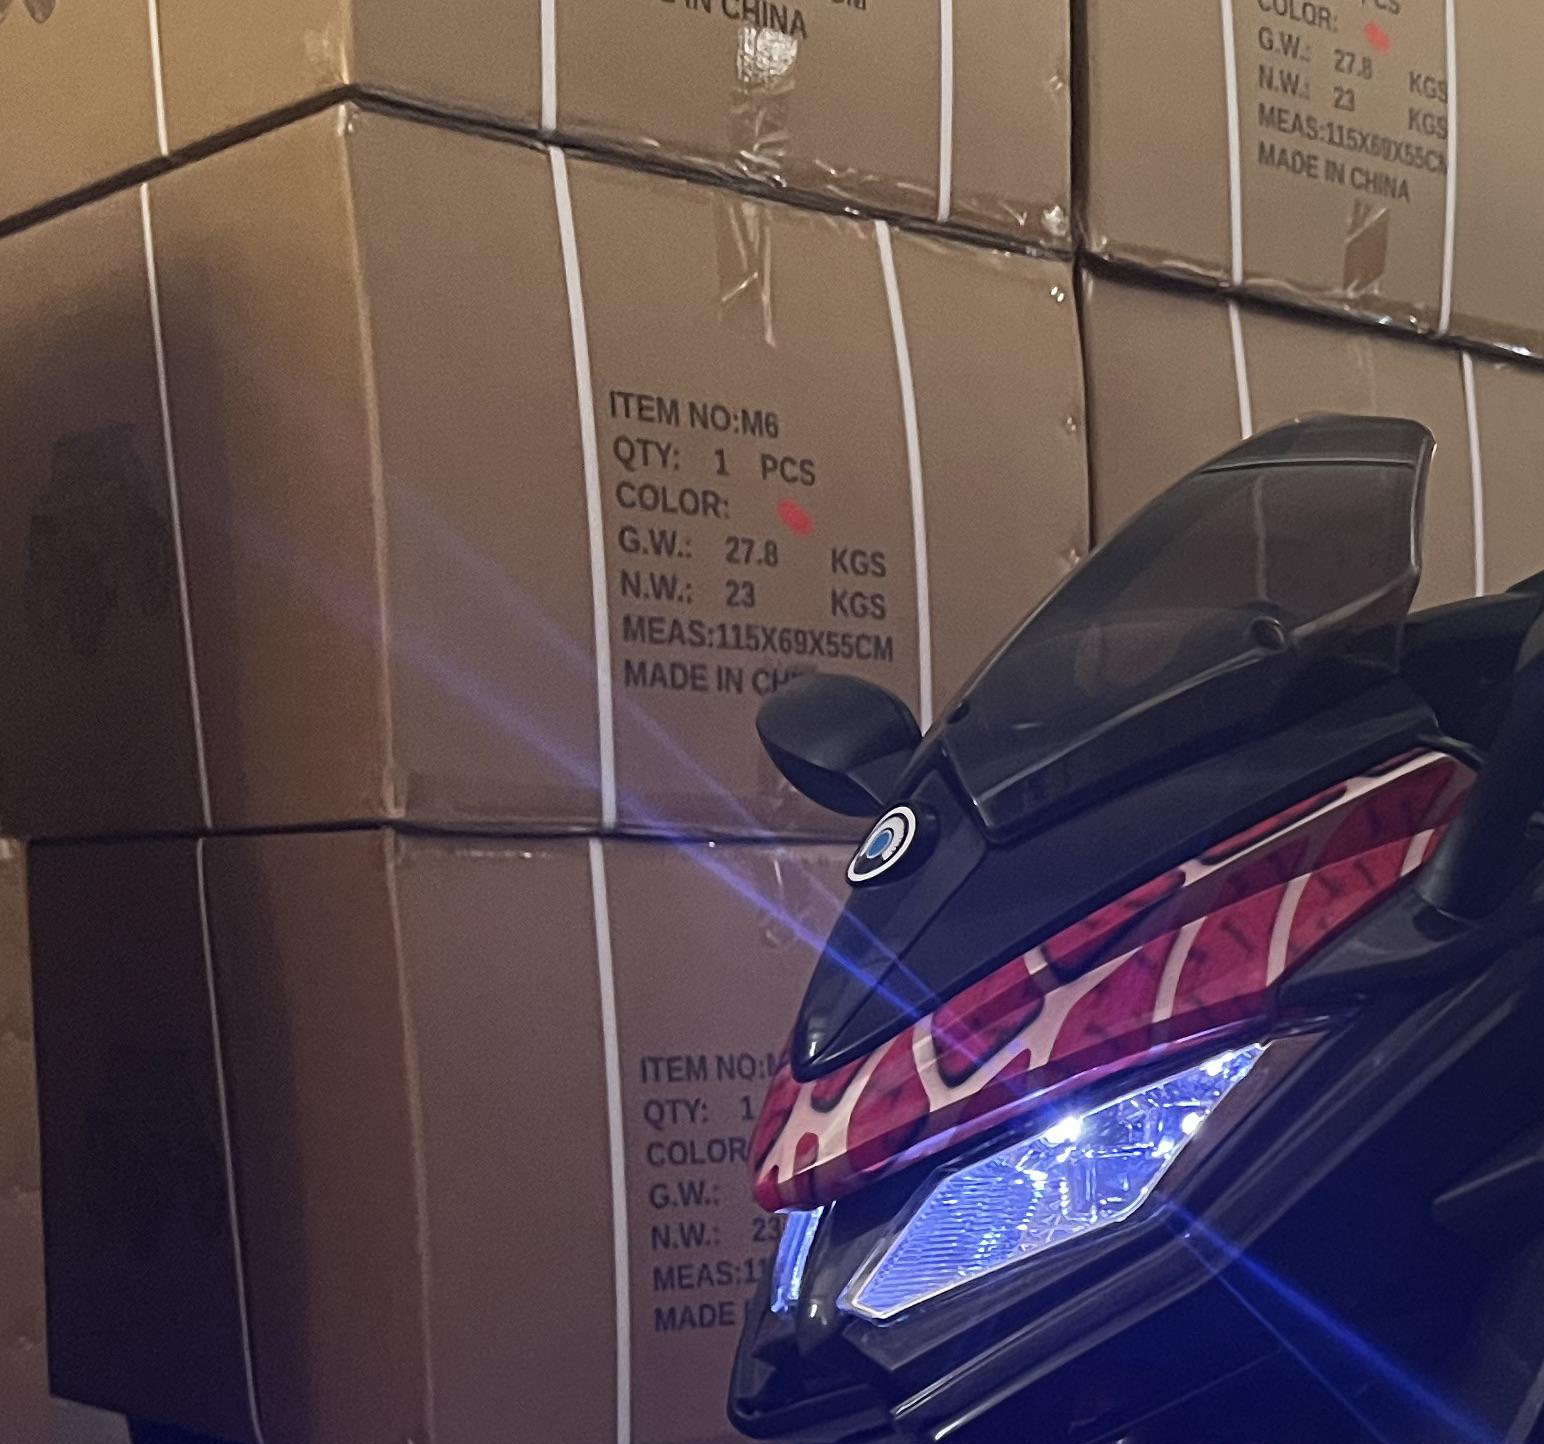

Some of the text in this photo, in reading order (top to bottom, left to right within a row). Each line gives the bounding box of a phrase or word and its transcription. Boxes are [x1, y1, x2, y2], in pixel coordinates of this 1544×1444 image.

[722, 0, 807, 39] CHINA
[1333, 49, 1373, 80] 27.8
[1408, 71, 1448, 104] KGS
[1333, 86, 1355, 112] 23
[1408, 107, 1448, 140] KGS
[1258, 141, 1410, 202] MADE IN CHINA
[609, 390, 779, 438] ITEM NO:M6
[612, 435, 816, 486] QTY: 1 PCS
[615, 481, 730, 519] COLOR:
[618, 525, 887, 578] G.W.: 27.8 KGS
[620, 570, 887, 620] N.W.: 23 KGS
[622, 615, 894, 662] MEAS:115X69X55CM
[623, 659, 708, 692] MADE
[716, 666, 743, 693] IN
[641, 1055, 708, 1083] ITEM
[644, 1096, 754, 1131] QTY: 1
[649, 1180, 719, 1209] G.W.:
[652, 1221, 719, 1249] N.W.:
[655, 1302, 736, 1333] MADE
